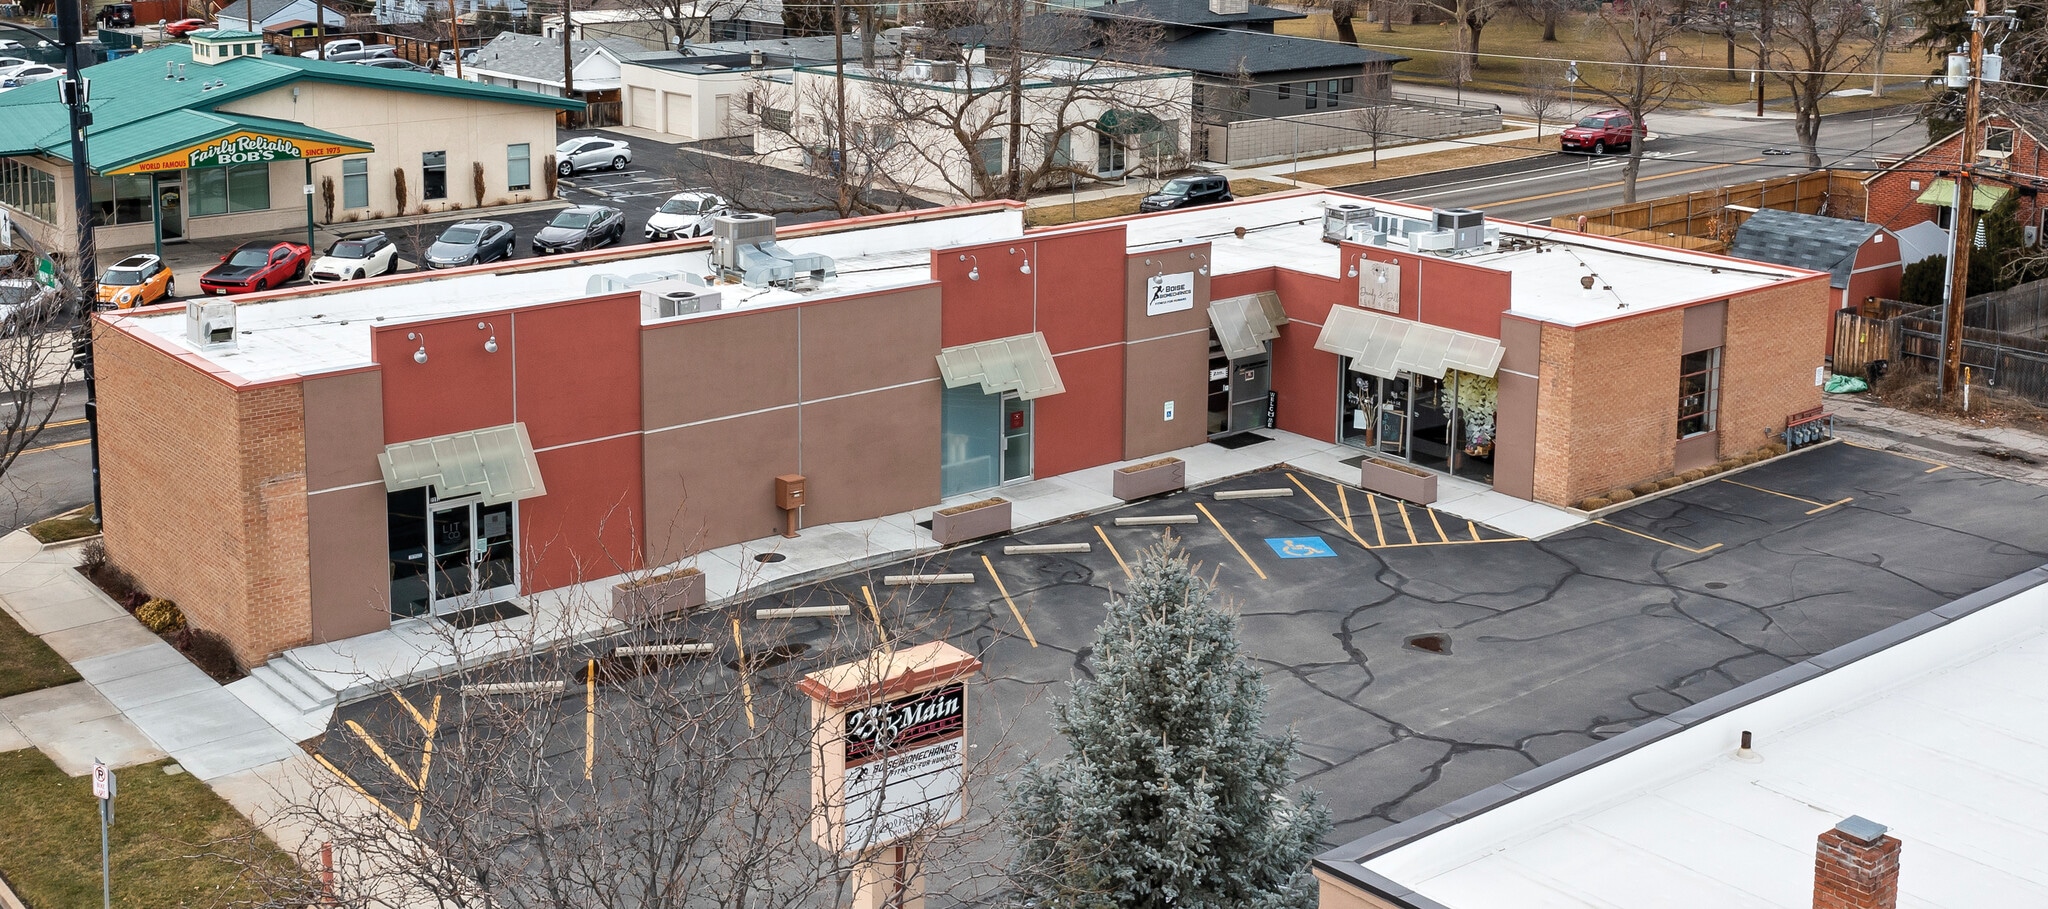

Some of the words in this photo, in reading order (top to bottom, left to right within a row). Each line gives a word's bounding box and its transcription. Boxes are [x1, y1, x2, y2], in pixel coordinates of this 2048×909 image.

[190, 139, 236, 167] Fairly
[237, 136, 300, 158] Reliable
[218, 149, 275, 165] BOB'S
[305, 148, 324, 156] SINCE
[326, 147, 341, 155] 1975
[139, 162, 161, 171] WORLD
[162, 160, 187, 169] FAMOUS
[1165, 284, 1186, 292] BOISE
[442, 522, 460, 534] LIT
[900, 695, 960, 729] Main
[873, 760, 898, 774] BOSE
